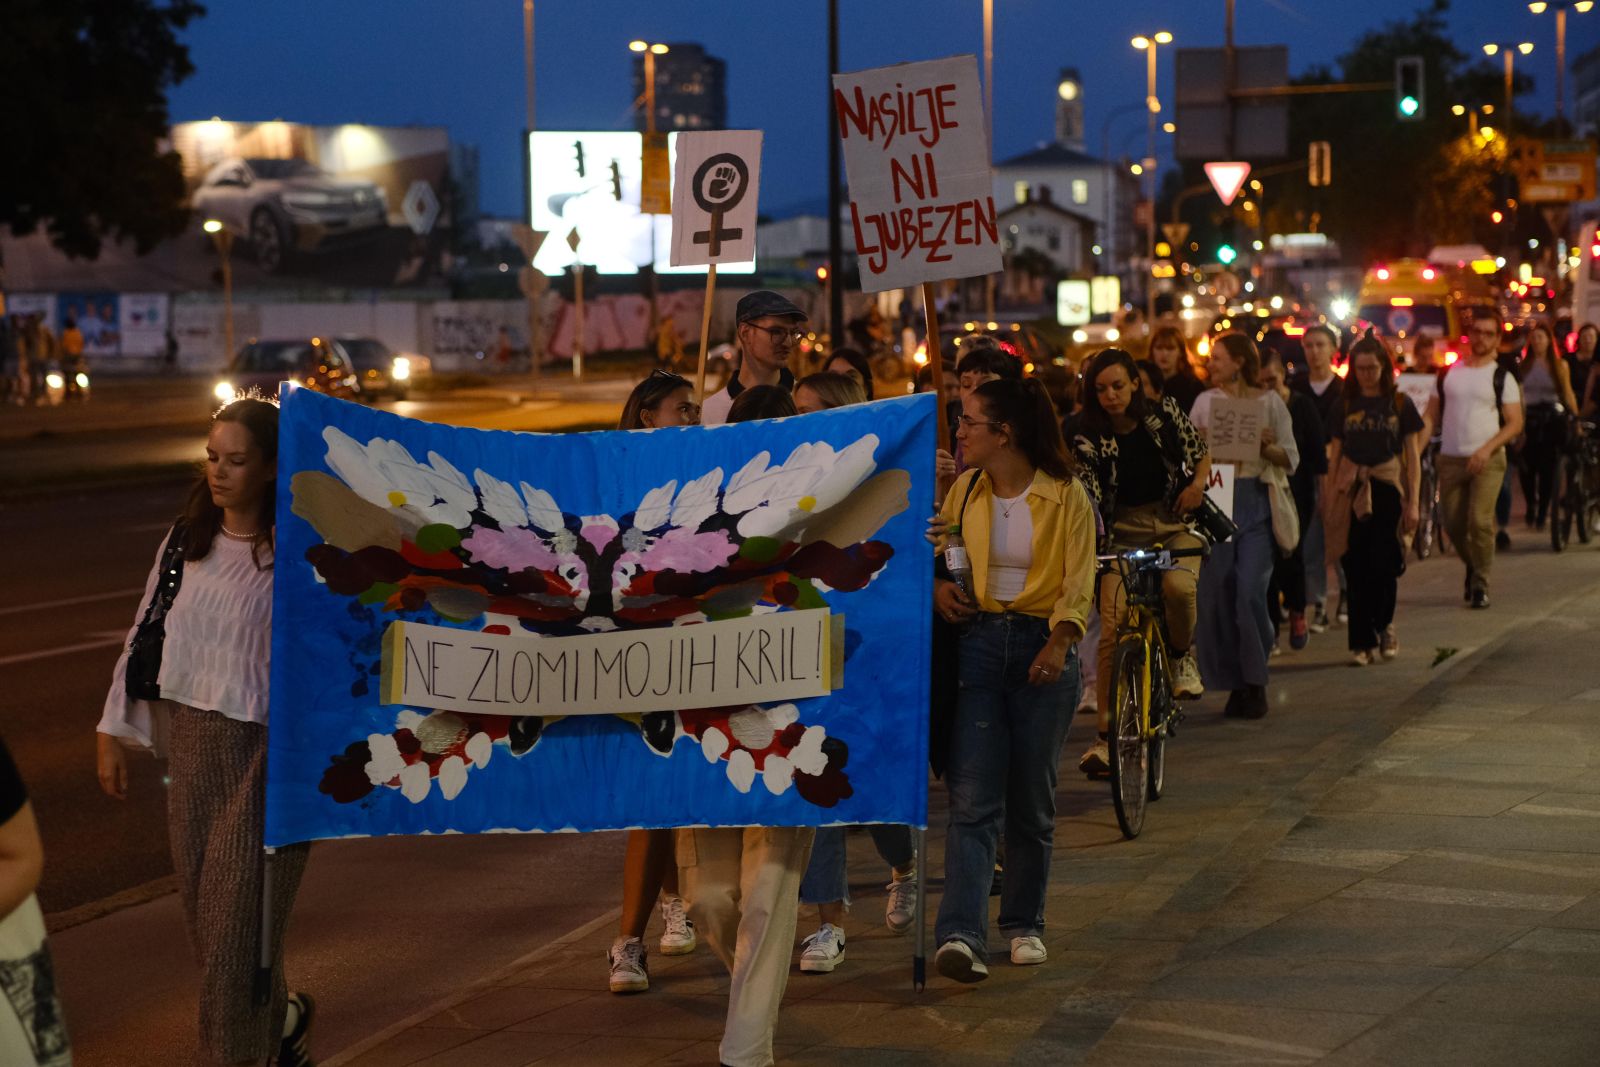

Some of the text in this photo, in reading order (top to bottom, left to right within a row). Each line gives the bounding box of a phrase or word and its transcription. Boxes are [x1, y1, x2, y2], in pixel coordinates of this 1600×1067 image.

[891, 153, 938, 203] NI
[851, 197, 999, 274] LJUBEZEN
[404, 620, 822, 703] NE ZLOMI MOJIH KRIL!
